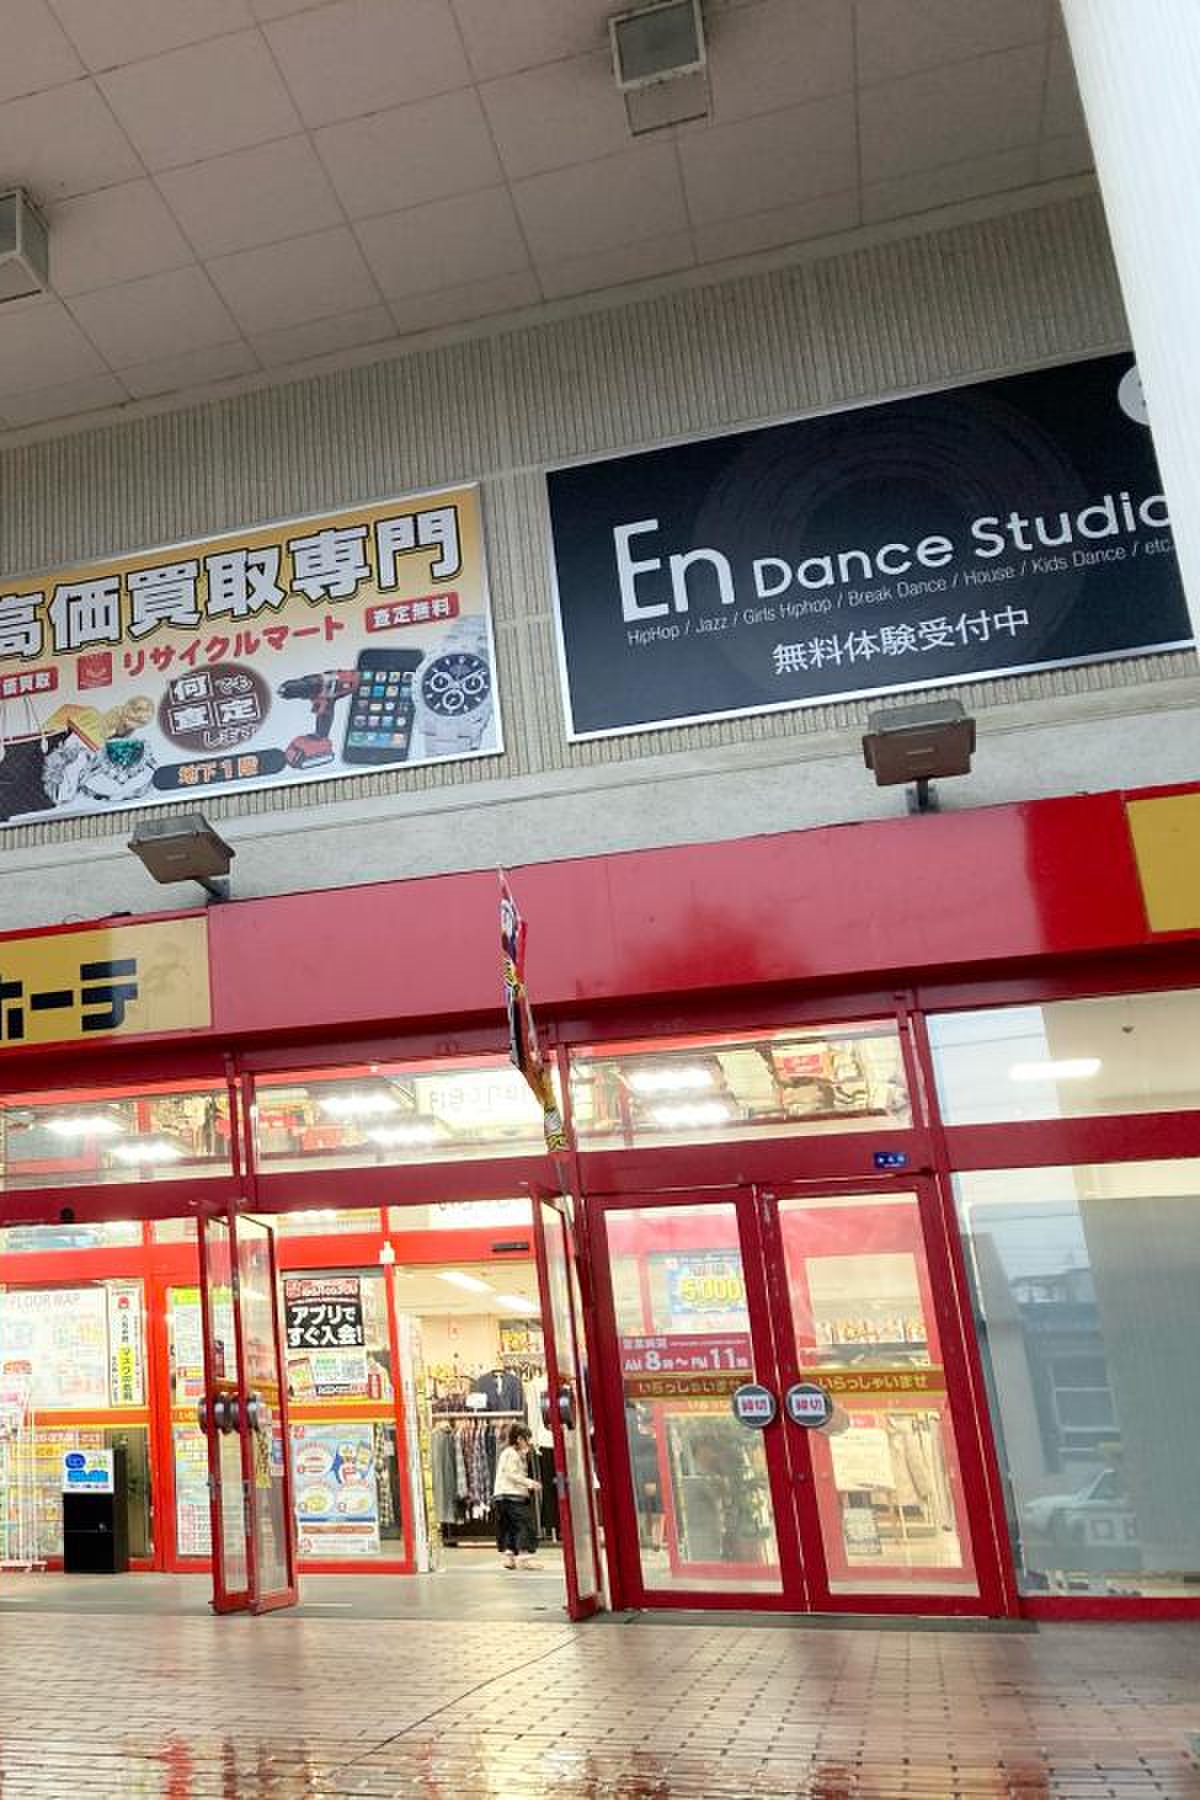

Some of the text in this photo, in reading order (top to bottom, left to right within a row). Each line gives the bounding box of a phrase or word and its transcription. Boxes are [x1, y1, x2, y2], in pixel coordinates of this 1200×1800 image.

[613, 492, 1169, 622] En Dance Studio
[627, 623, 680, 647] HipHop
[696, 616, 728, 634] Jazz
[743, 606, 775, 625] Girls
[848, 586, 892, 607] Break
[897, 578, 947, 598] Dance
[964, 566, 1014, 586] House
[1032, 553, 1068, 574] Kids
[1073, 546, 1125, 567] Dance
[123, 615, 344, 677] リサイクルマート
[773, 605, 1029, 675] 無料体験受付中
[291, 1304, 356, 1325] アプリで
